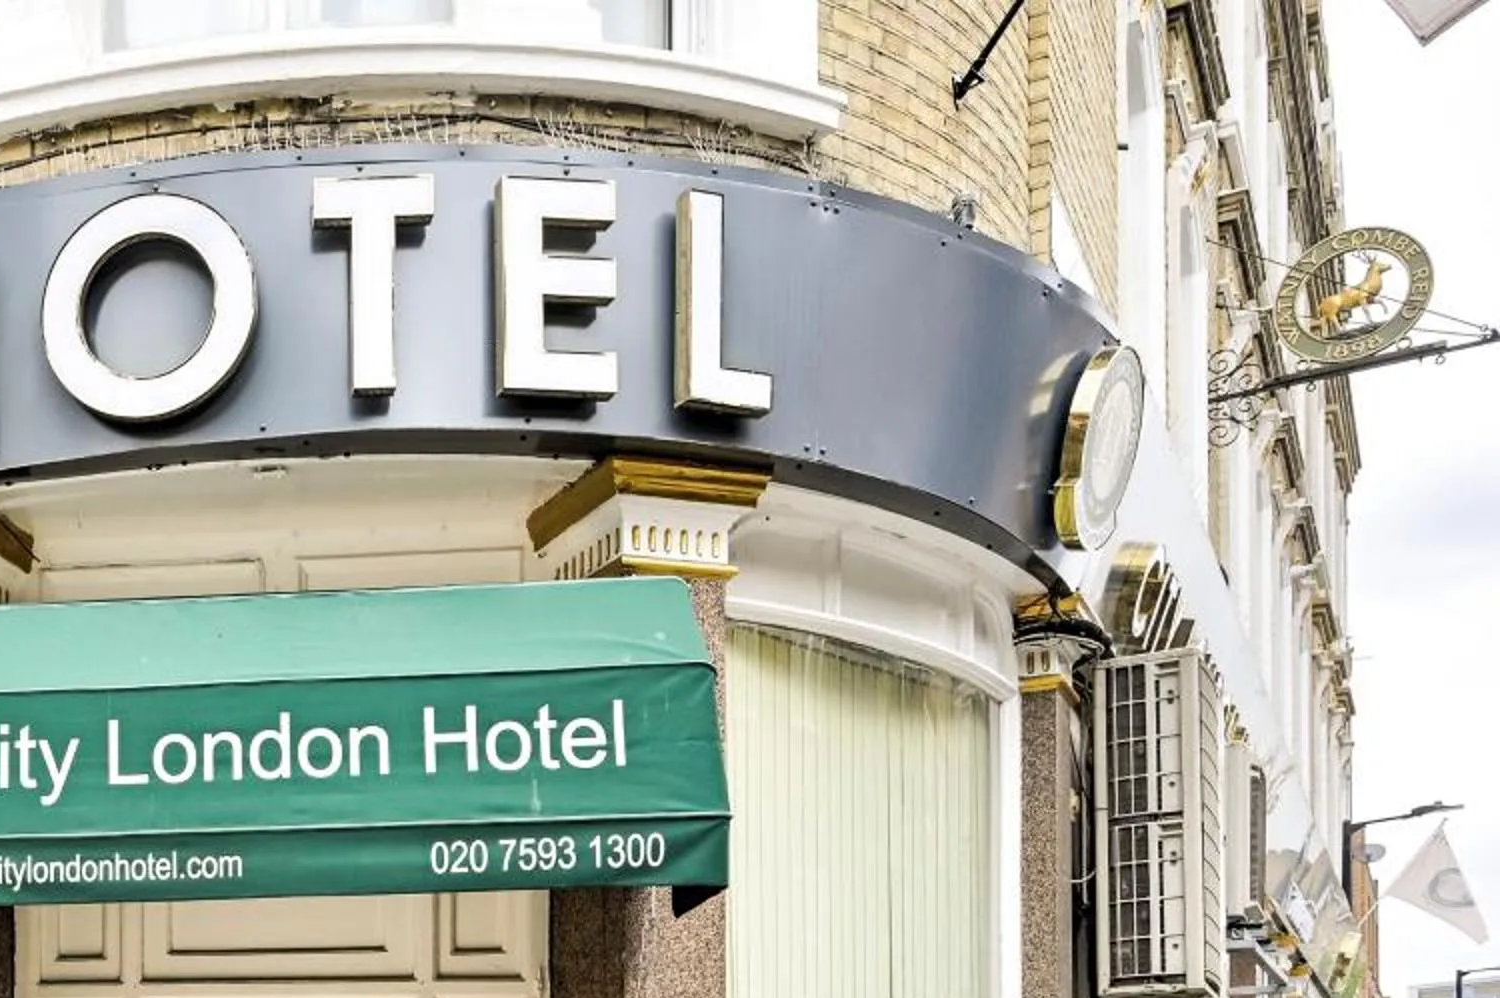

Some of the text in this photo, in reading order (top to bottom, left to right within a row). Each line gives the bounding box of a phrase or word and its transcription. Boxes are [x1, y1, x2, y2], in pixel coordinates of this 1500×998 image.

[1332, 228, 1421, 260] COMBE
[1401, 267, 1430, 319] REID
[107, 711, 390, 786] London
[422, 699, 627, 774] Hotel
[430, 832, 666, 875] 020 7593 1300
